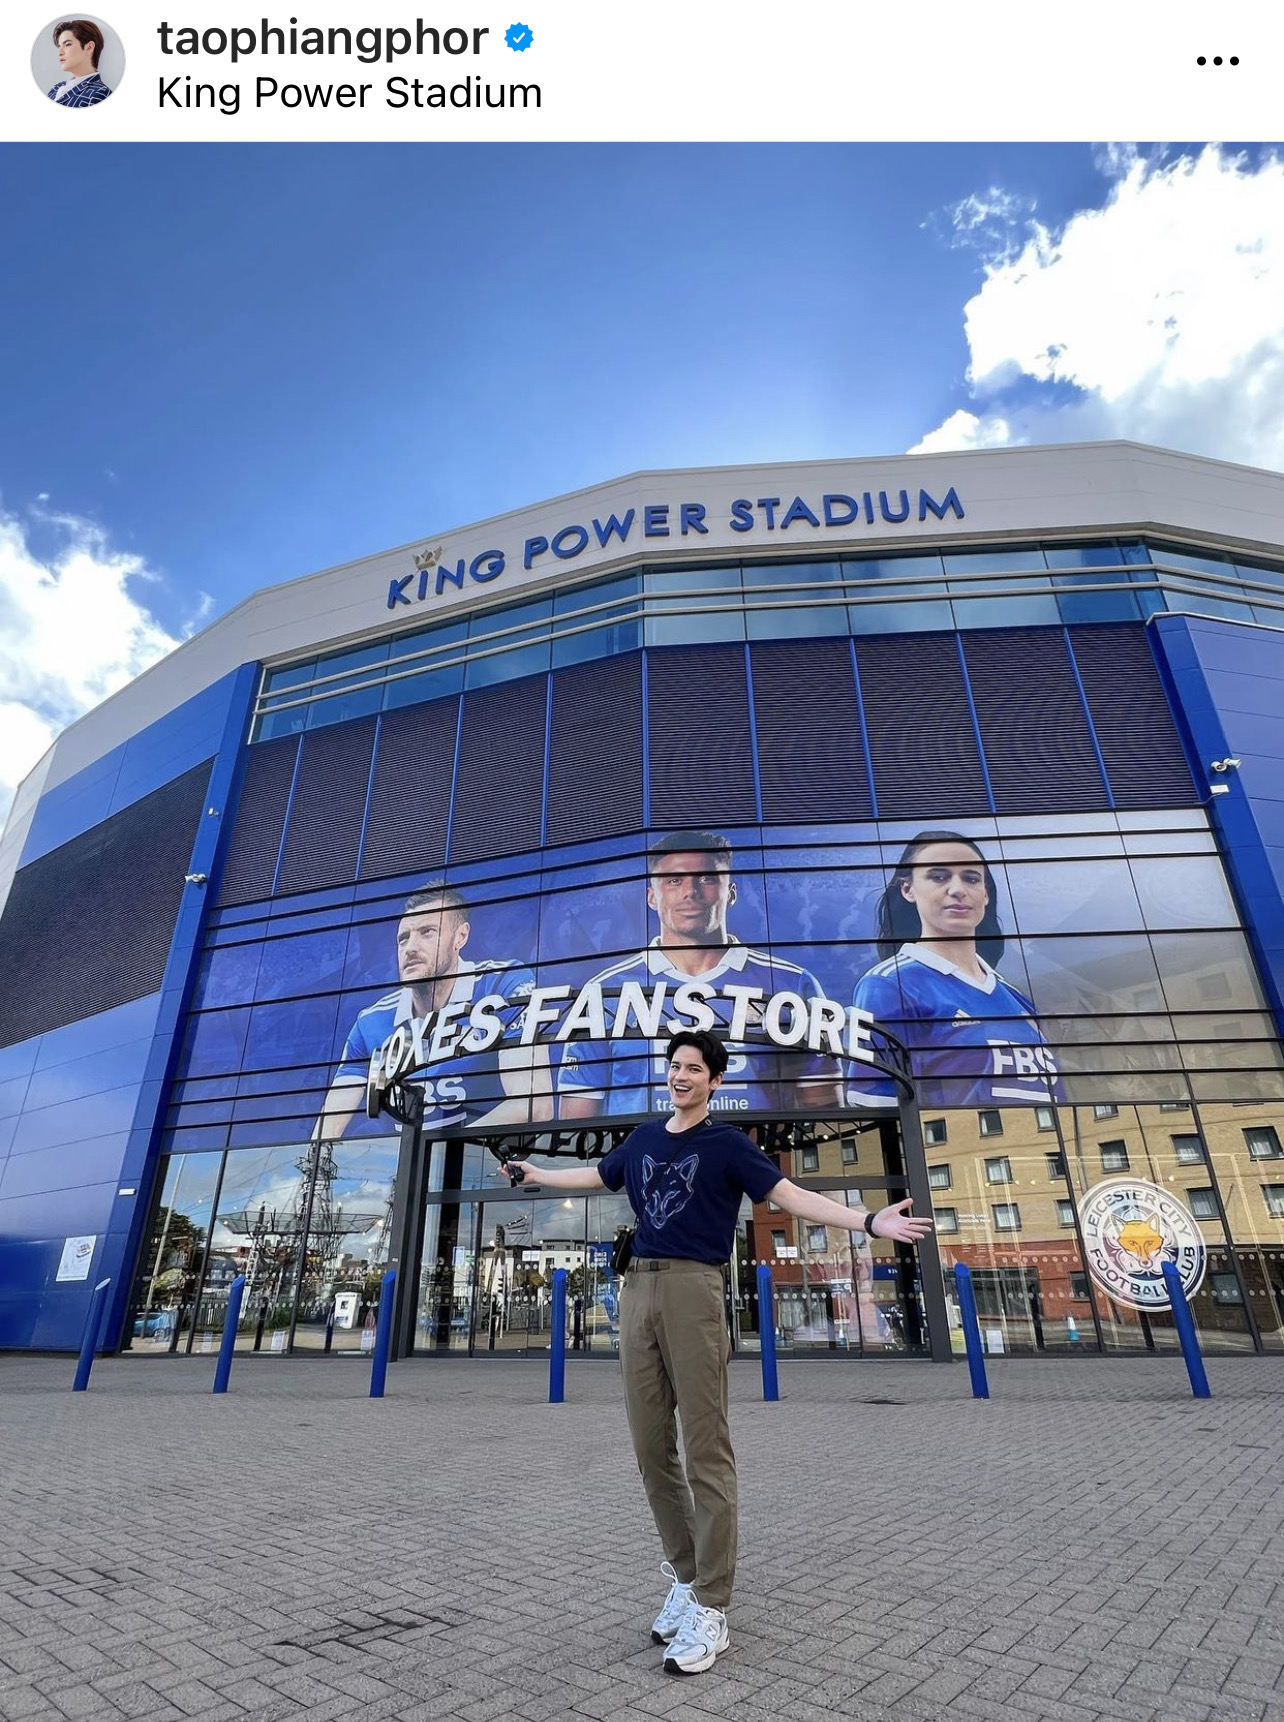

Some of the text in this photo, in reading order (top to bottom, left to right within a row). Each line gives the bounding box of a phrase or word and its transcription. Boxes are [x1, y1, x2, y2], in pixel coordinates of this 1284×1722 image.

[387, 487, 965, 609] KING POWER STADIUM
[375, 994, 510, 1091] FOXES
[986, 1039, 1058, 1086] FBS
[1086, 1189, 1192, 1238] LEICESTER CITY
[1179, 1246, 1196, 1285] LUB
